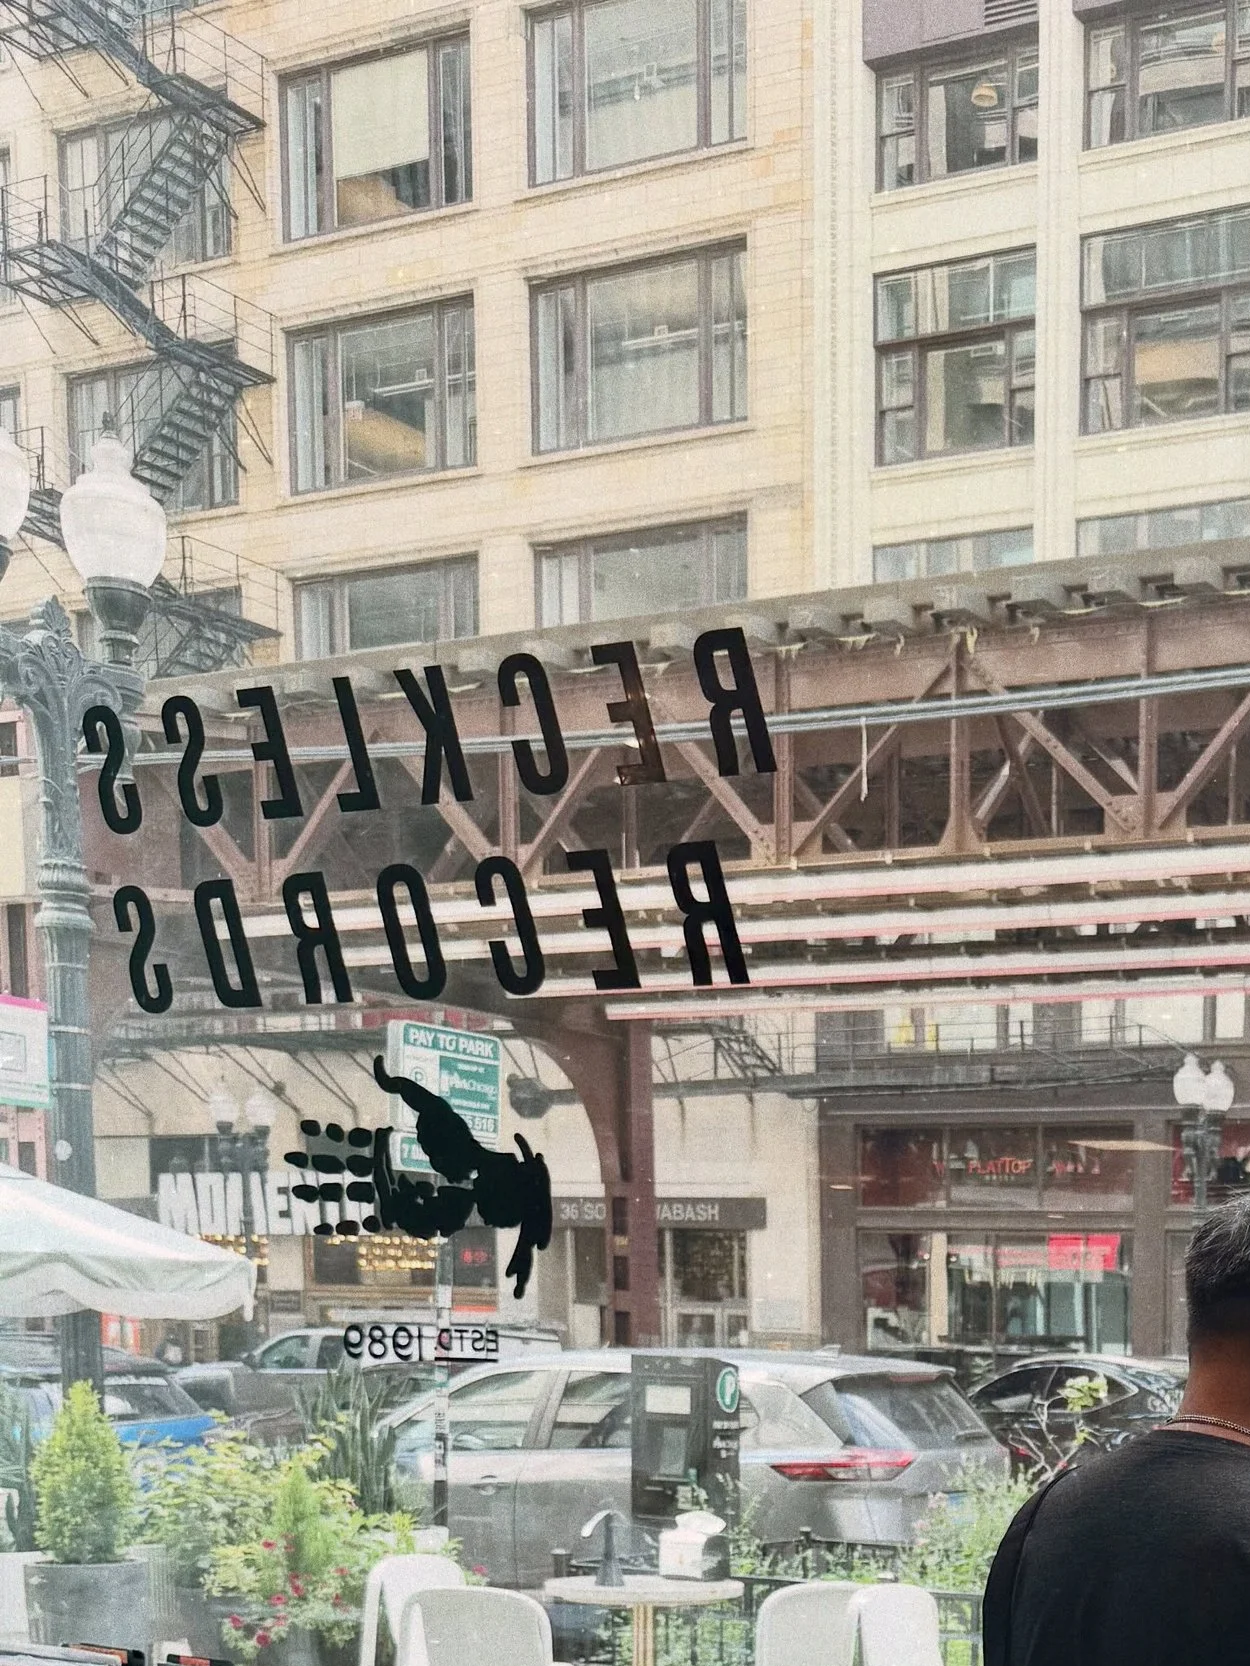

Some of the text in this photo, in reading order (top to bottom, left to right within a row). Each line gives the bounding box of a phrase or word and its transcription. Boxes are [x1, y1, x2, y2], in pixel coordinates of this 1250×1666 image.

[409, 1029, 434, 1050] PAY
[458, 1037, 494, 1058] PARK
[559, 1203, 576, 1220] 36
[656, 1203, 720, 1222] ABASH
